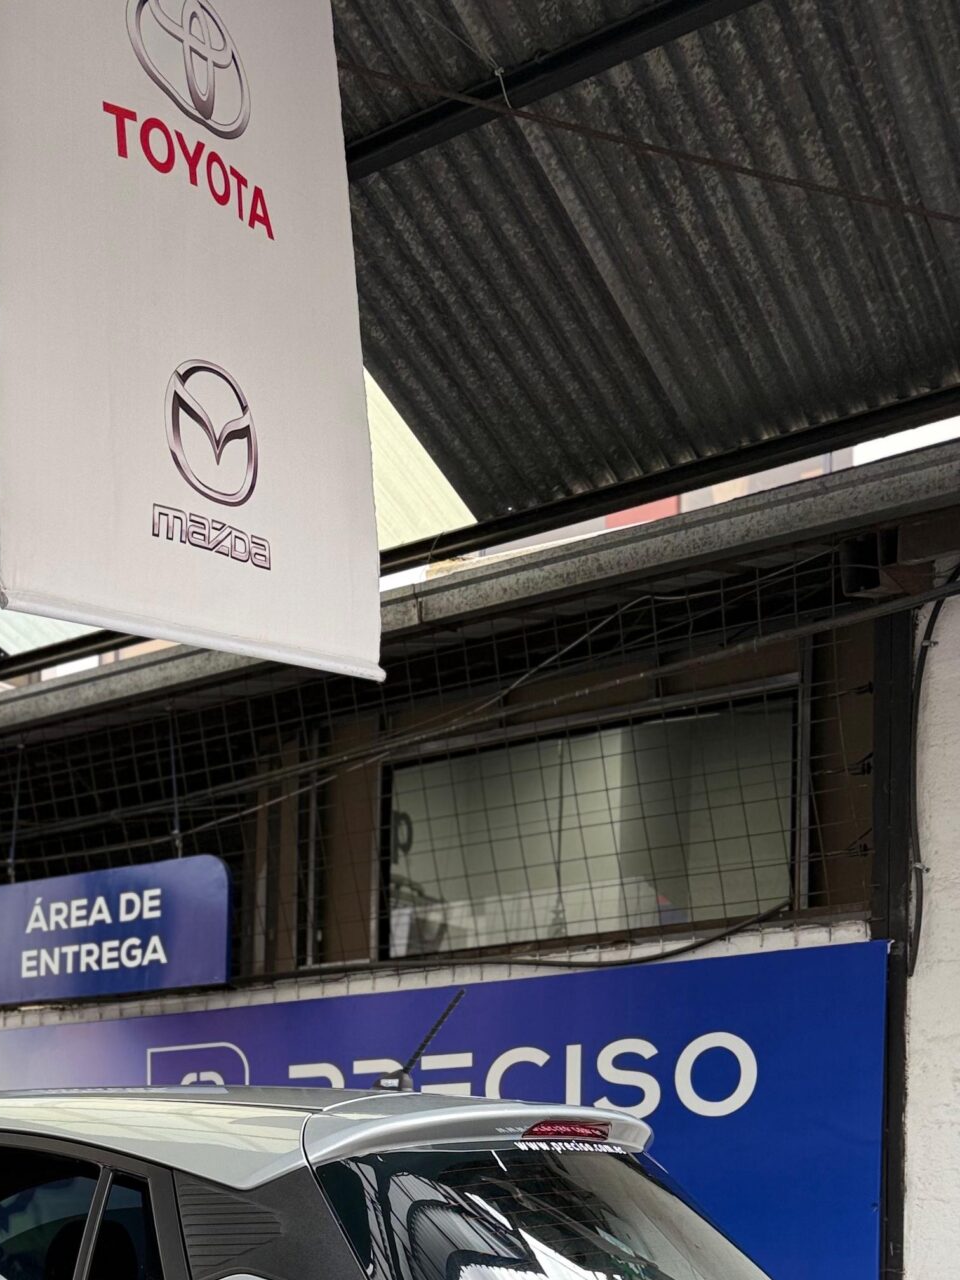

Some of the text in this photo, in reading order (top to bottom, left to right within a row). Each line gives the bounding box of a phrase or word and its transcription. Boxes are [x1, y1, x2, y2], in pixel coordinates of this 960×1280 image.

[102, 101, 275, 240] TOYOTA
[25, 888, 162, 934] ÁREA DE
[21, 935, 167, 978] ENTREGA
